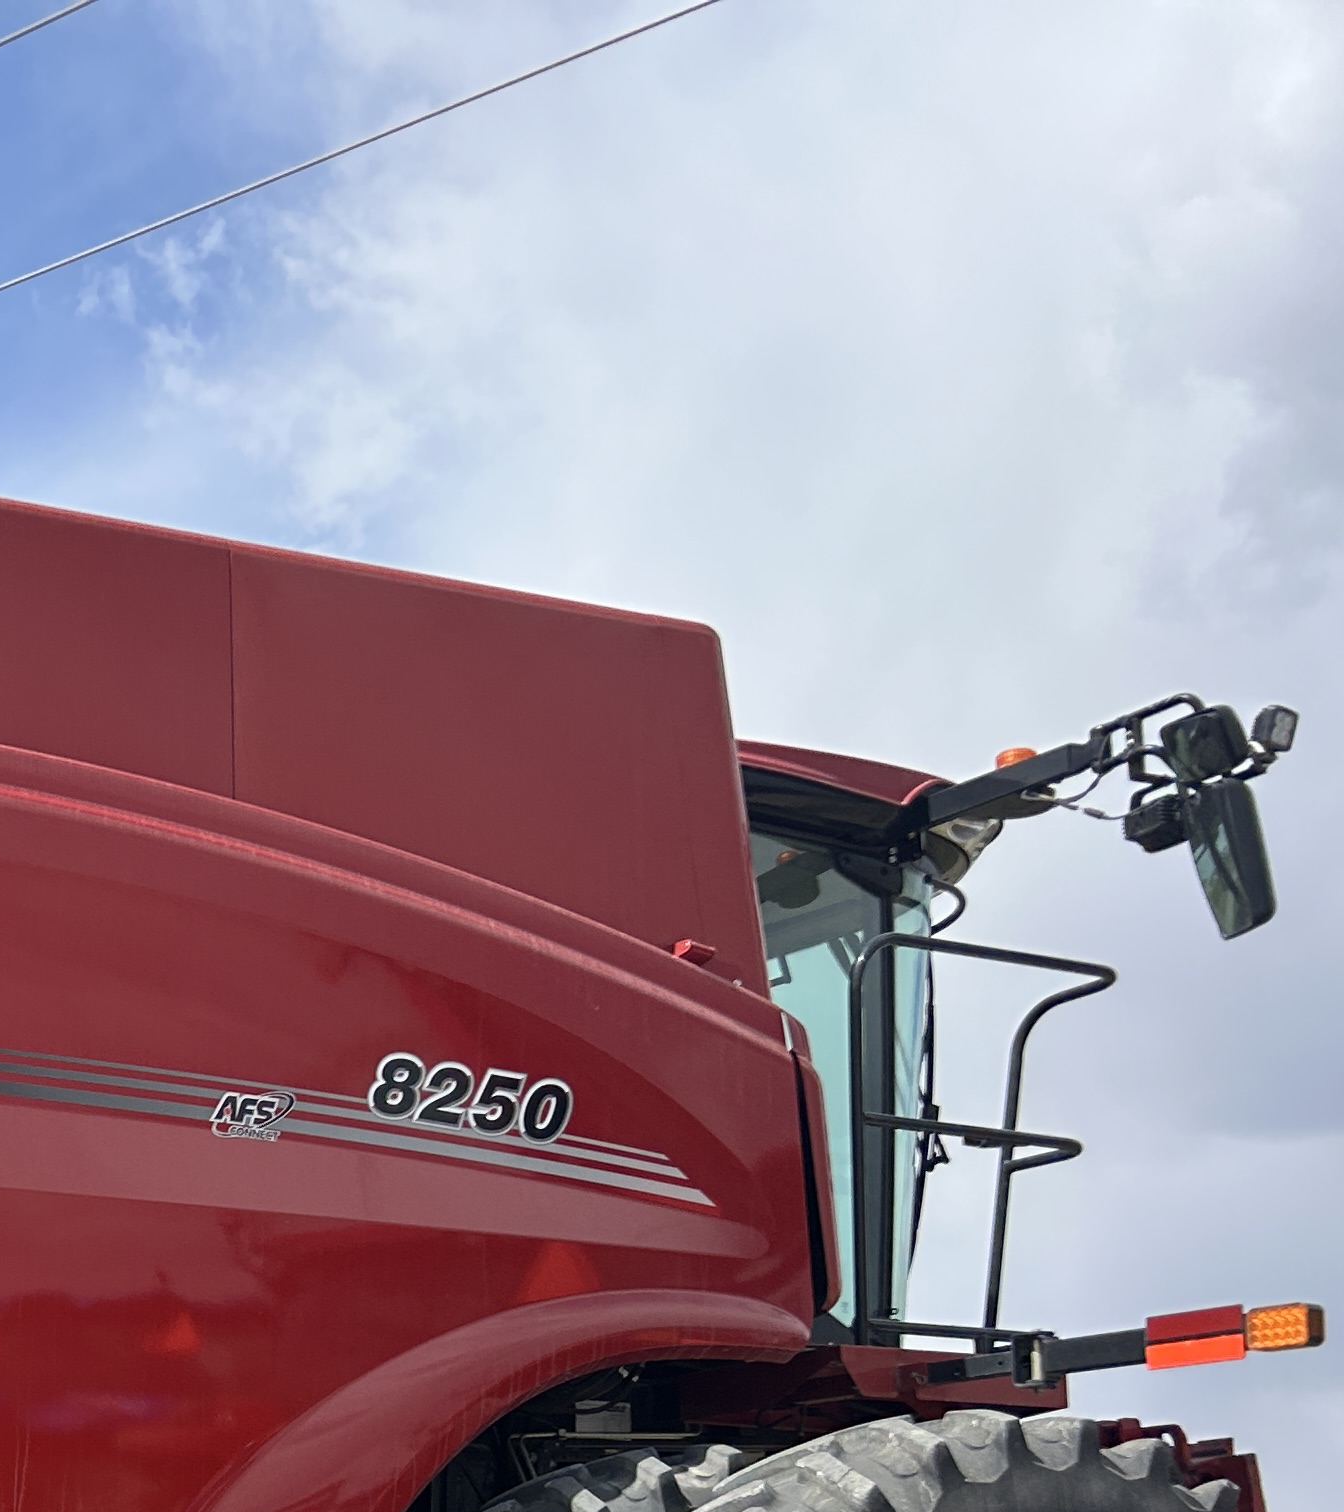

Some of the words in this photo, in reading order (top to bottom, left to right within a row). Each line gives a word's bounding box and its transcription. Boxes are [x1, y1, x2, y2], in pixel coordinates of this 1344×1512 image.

[211, 1093, 278, 1126] AFS
[368, 1052, 573, 1145] 8250
[229, 1126, 279, 1141] CONNECT
